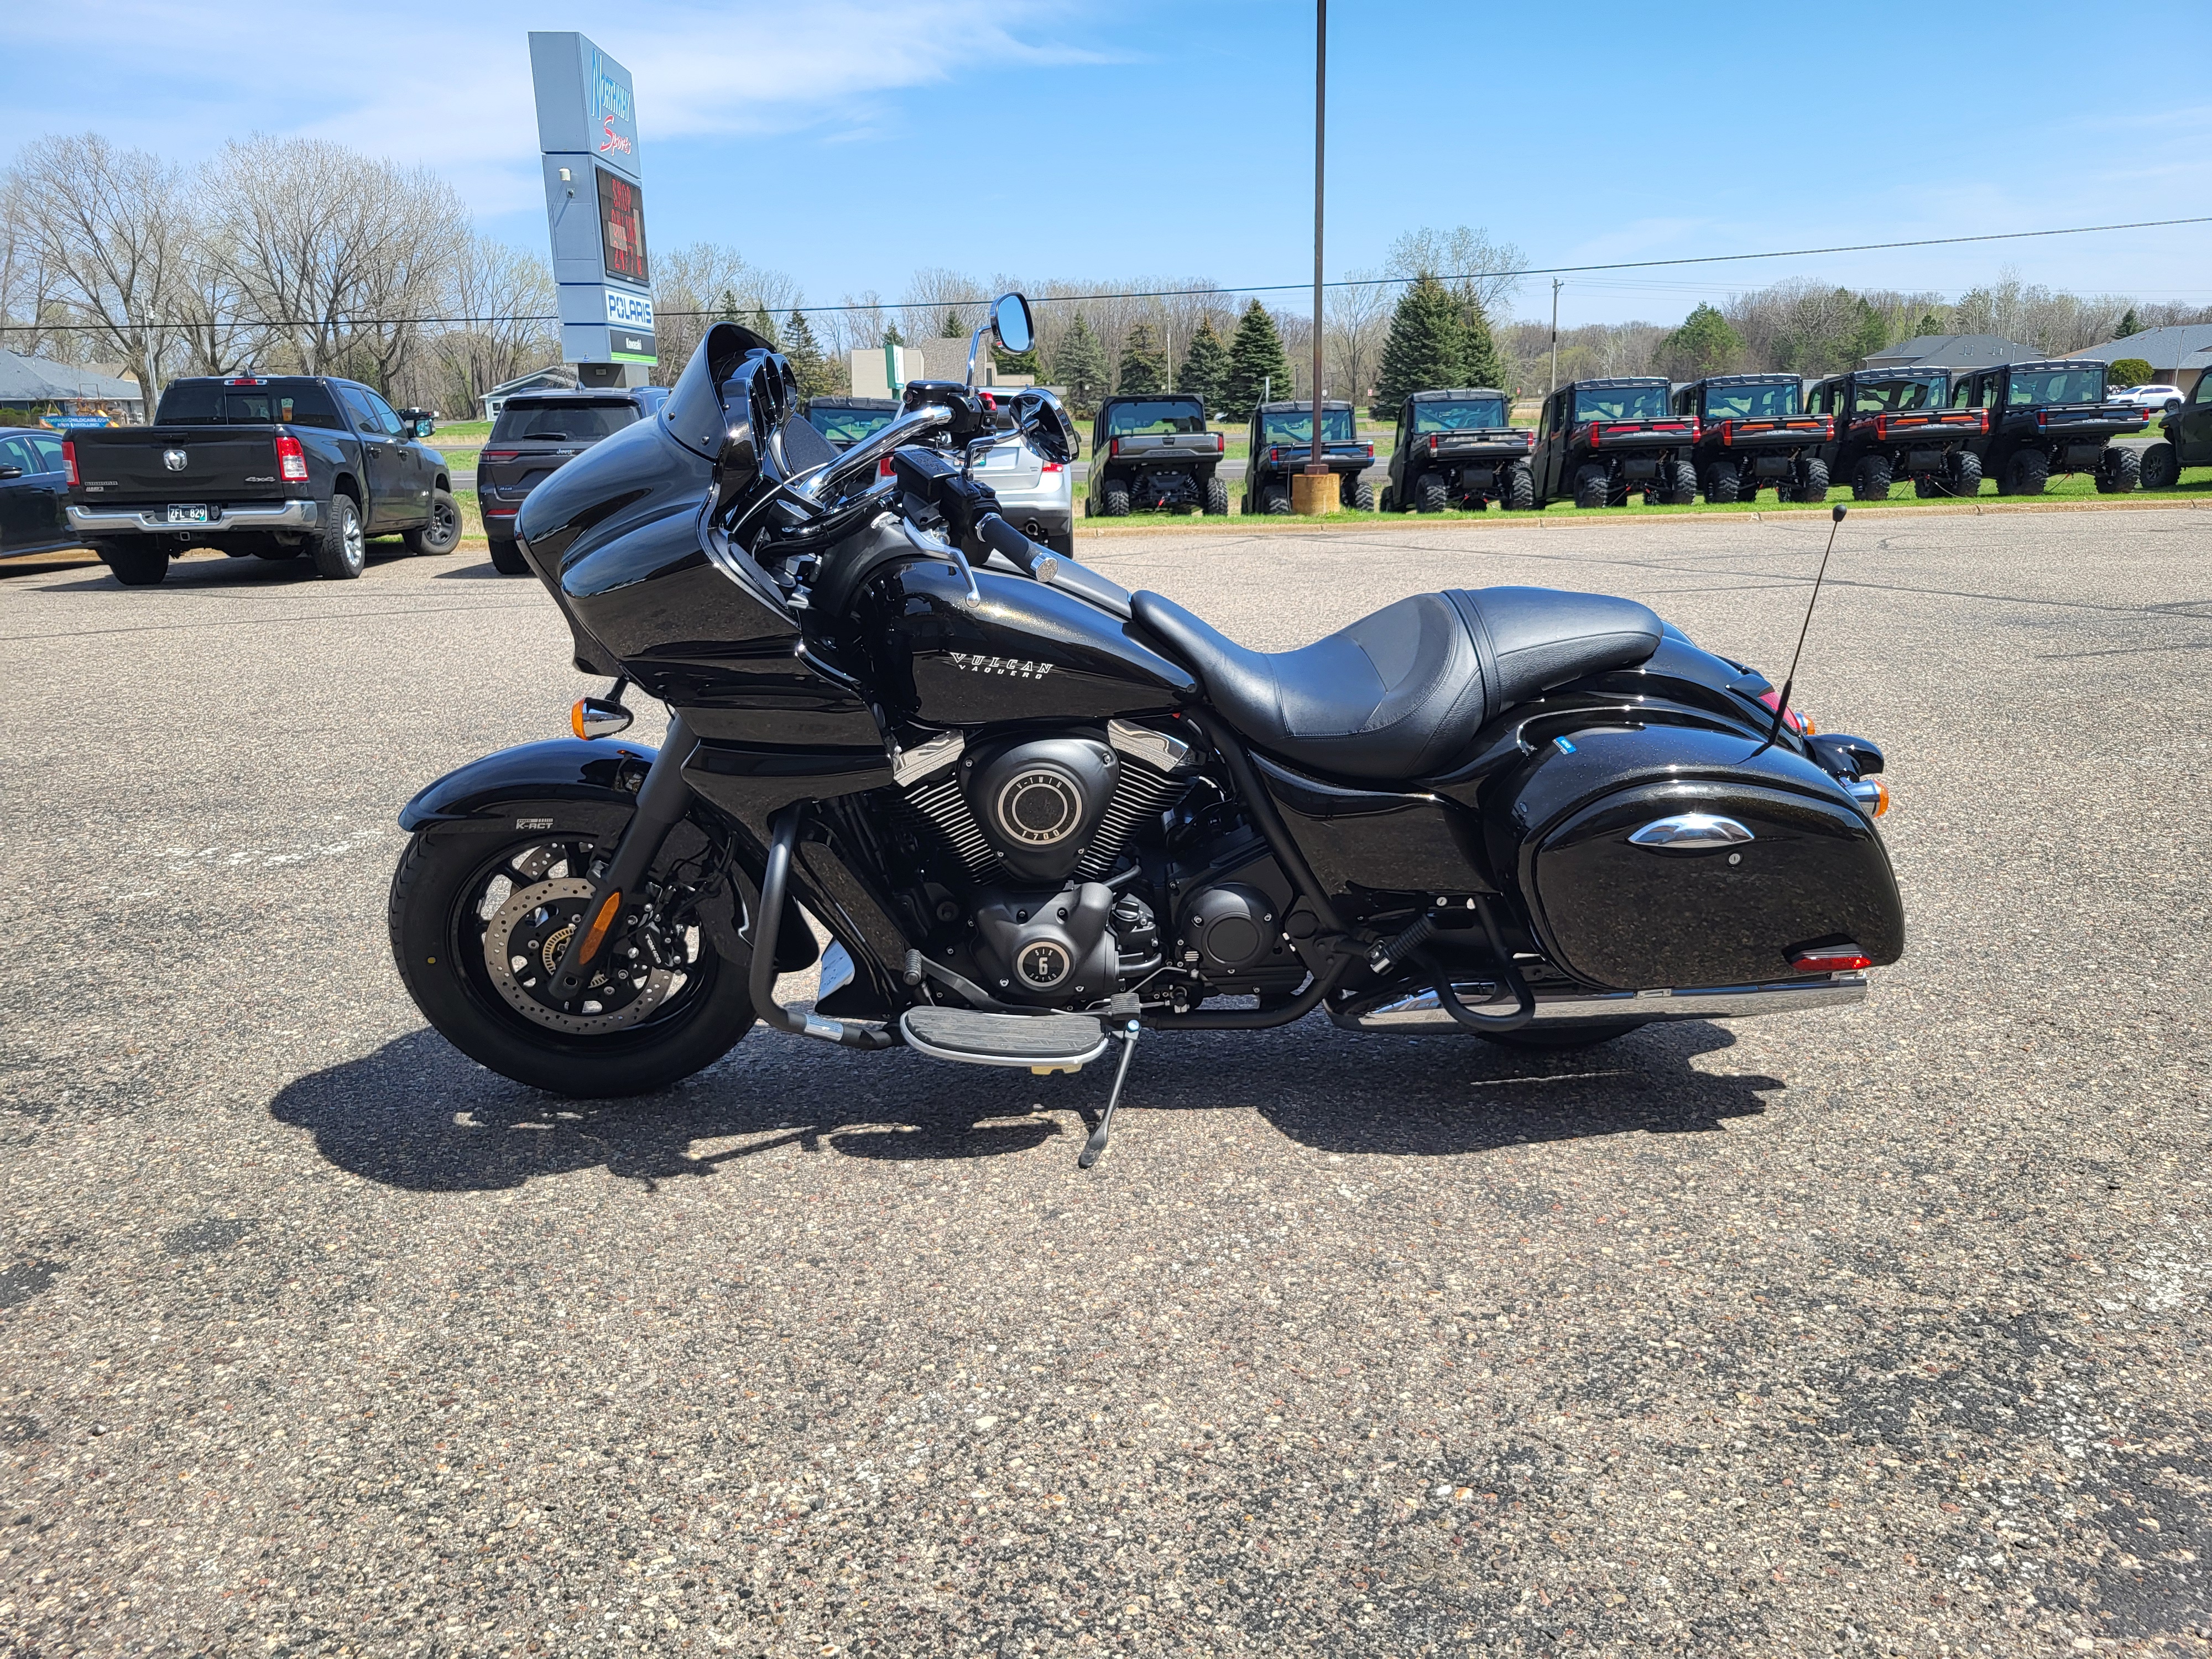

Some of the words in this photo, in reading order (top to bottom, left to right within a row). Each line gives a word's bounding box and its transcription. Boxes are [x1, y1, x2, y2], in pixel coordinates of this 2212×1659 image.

[612, 179, 631, 213] SHOP
[608, 294, 651, 325] POLARIS
[170, 508, 185, 518] ZFL
[190, 508, 204, 518] 829
[950, 652, 1053, 674] VULCAN
[958, 665, 1042, 680] VAQUERO
[1016, 776, 1062, 789] V-TWIN
[1022, 830, 1060, 841] 1700
[645, 933, 661, 964] TOKICO
[1035, 948, 1053, 956] SIX
[1039, 957, 1048, 975] 6
[1029, 973, 1057, 982] SPEED
